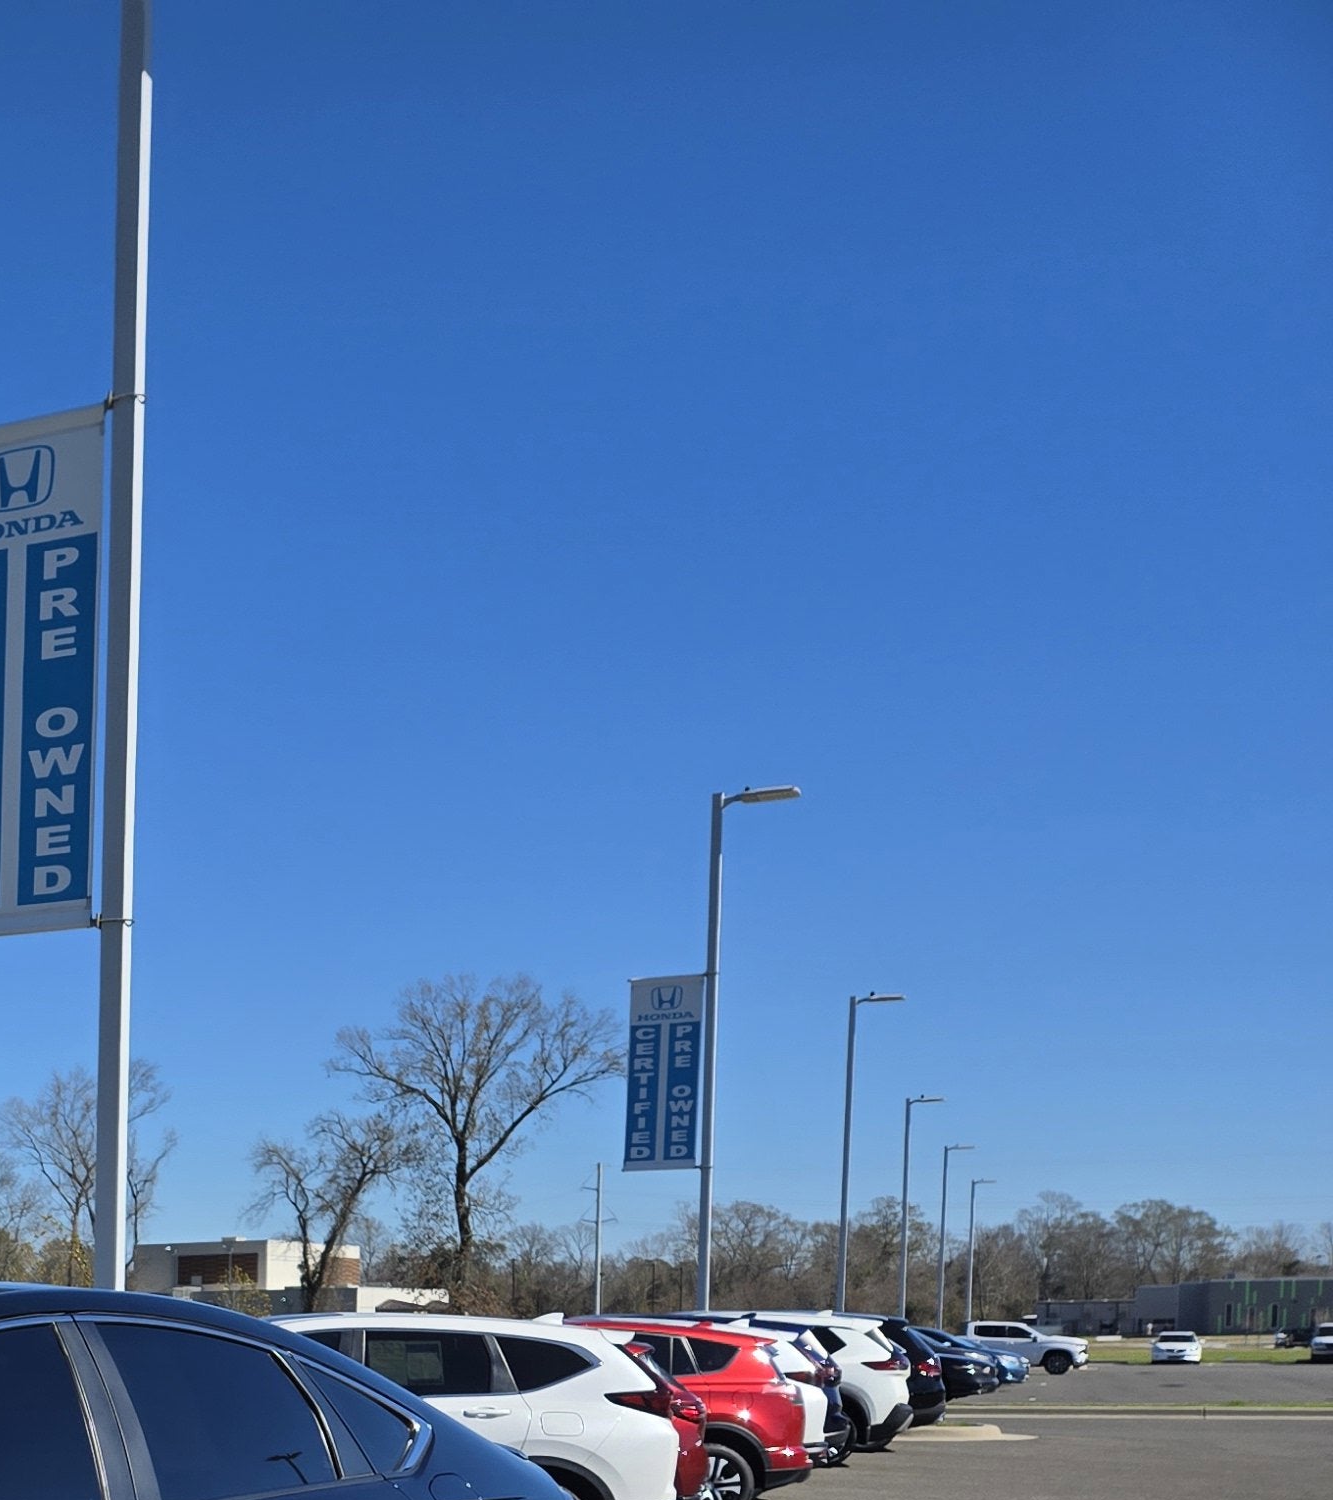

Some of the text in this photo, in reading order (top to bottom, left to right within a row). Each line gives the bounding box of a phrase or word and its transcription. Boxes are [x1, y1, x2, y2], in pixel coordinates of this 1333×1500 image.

[28, 546, 85, 896] PRE OWNED
[637, 1011, 695, 1022] HONDA
[630, 1028, 655, 1159] CERTIFIED
[669, 1025, 694, 1158] PRE OWNED
